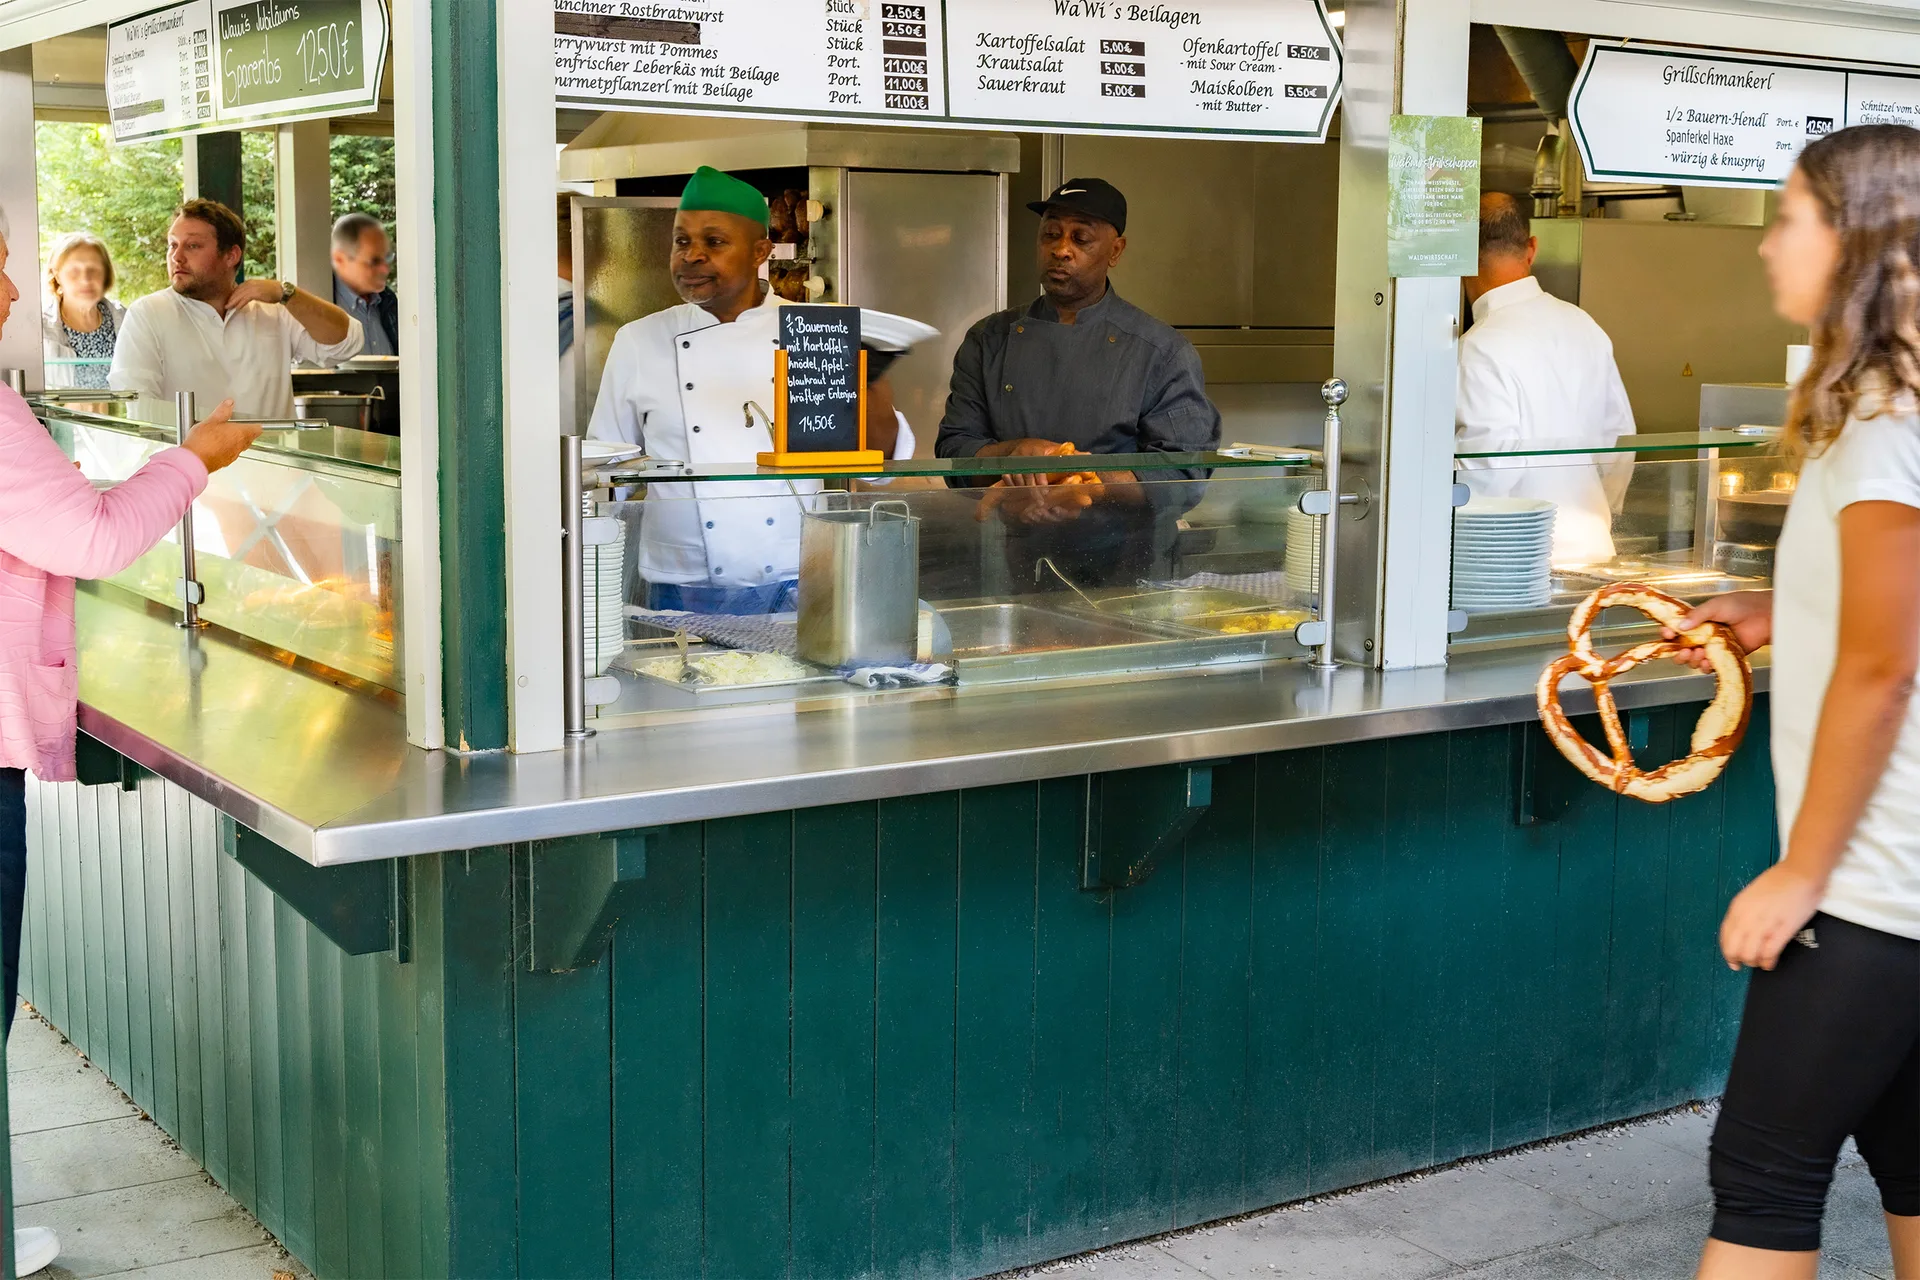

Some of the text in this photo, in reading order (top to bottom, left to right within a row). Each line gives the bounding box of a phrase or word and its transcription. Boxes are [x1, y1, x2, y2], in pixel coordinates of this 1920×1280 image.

[620, 2, 724, 23] Rostbratwurst
[827, 0, 855, 14] Stück
[885, 5, 923, 20] 2,50€
[1127, 4, 1202, 30] Beilagen
[825, 19, 863, 34] Stück
[886, 22, 923, 37] 2,50€
[629, 41, 656, 55] mit
[660, 43, 718, 60] Pommes
[826, 36, 864, 51] Stück
[975, 32, 1086, 56] Kartoffelsalat
[1102, 42, 1133, 54] 5,00€
[1182, 37, 1282, 62] Ofenkartoffel
[1291, 46, 1319, 59] 5,50€
[555, 52, 780, 86] enfrischer Leberkäs mit Beilage
[827, 54, 860, 69] Port.
[884, 59, 925, 74] 11,00€
[976, 53, 1064, 73] Krautsalat
[1104, 63, 1137, 75] 5,00€
[1187, 58, 1207, 70] mit
[1209, 59, 1236, 72] Sour
[1239, 60, 1275, 73] Cream
[224, 34, 282, 105] Spareribs
[828, 72, 861, 87] Port.
[885, 77, 924, 91] 11,00€
[977, 75, 1066, 94] Sauerkraut
[1662, 65, 1775, 90] Grillschmankerl
[673, 81, 698, 95] mit
[702, 82, 753, 102] Beilage
[1105, 84, 1136, 97] 5,00€
[1190, 79, 1274, 97] Maiskolben
[828, 90, 862, 104] Port.
[886, 94, 927, 109] 11,00€
[1202, 99, 1222, 111] mit
[1225, 100, 1262, 113] Butter
[1860, 100, 1896, 113] Schnitzel
[1896, 106, 1912, 114] vom
[1666, 105, 1769, 128] 1/2 Bauern-Hendl
[1775, 117, 1793, 128] Port.
[1860, 113, 1889, 124] Chicken
[1666, 128, 1734, 146] Spanferkel Haxe
[1775, 141, 1793, 150] Port.
[1671, 150, 1708, 169] würzig
[1710, 153, 1719, 166] &
[1721, 152, 1766, 173] knusprig
[795, 315, 849, 334] Bauernente
[786, 340, 800, 353] mit
[788, 356, 820, 372] knödel,
[787, 374, 846, 387] blaukraut und
[789, 388, 825, 406] kräftiger
[799, 413, 837, 433] 14,50€
